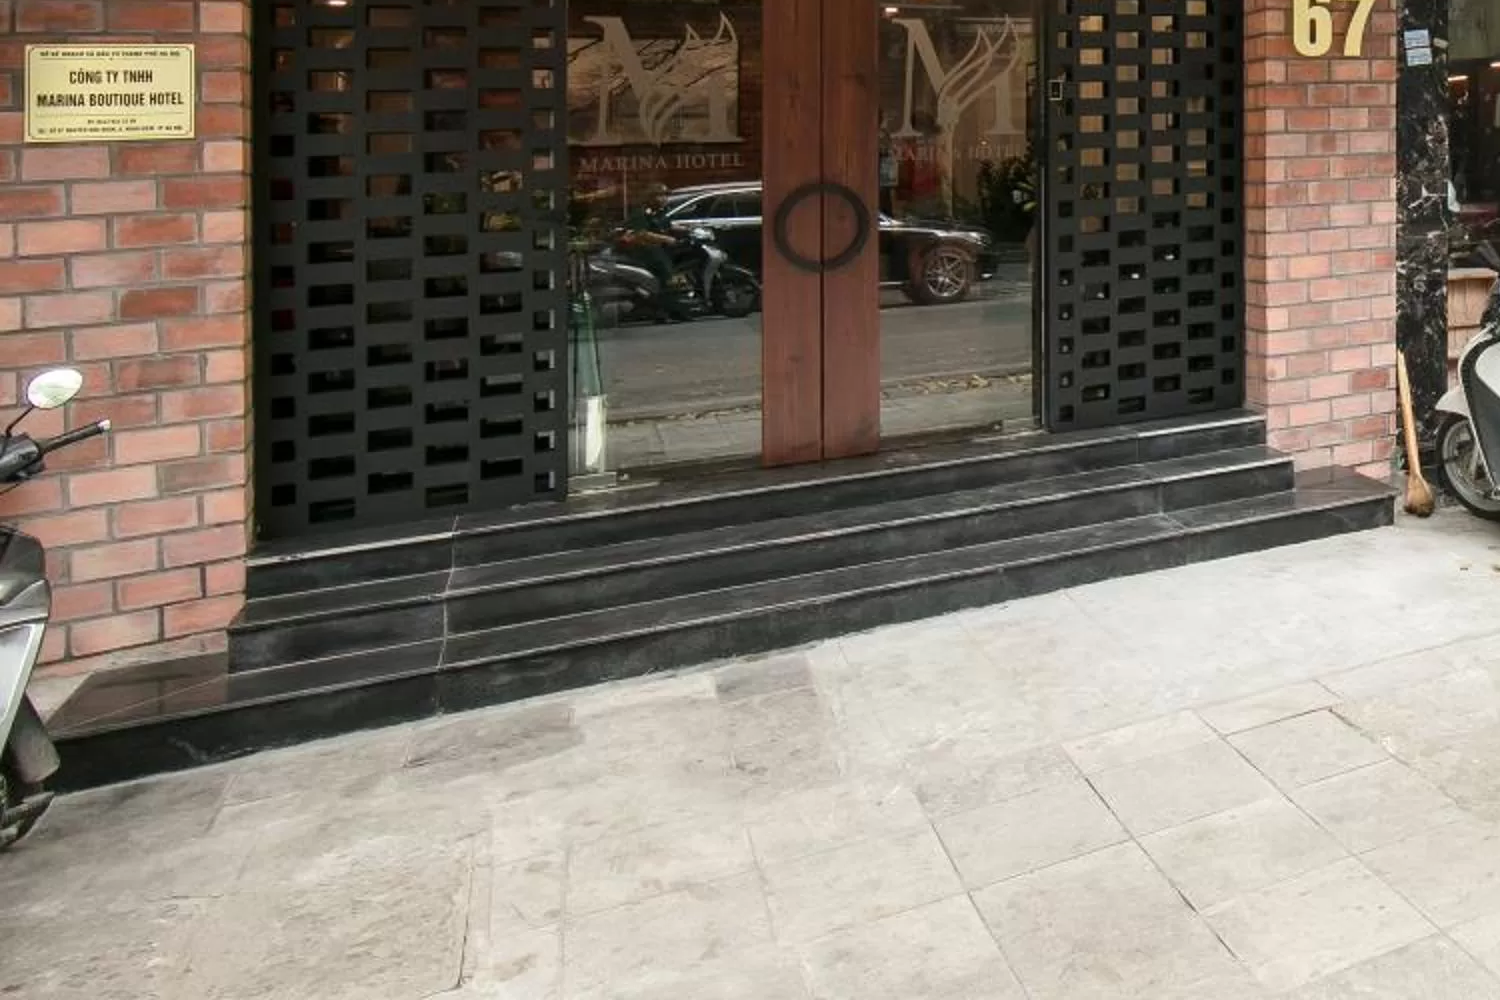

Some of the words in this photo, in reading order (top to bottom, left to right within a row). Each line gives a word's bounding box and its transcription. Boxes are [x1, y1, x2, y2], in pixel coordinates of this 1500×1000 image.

[69, 68, 102, 84] CÔNG
[106, 70, 118, 84] TY
[123, 69, 153, 84] TNHH
[36, 93, 85, 108] MARINA
[89, 92, 145, 107] BOUTIQUE
[149, 91, 184, 105] HOTEL
[676, 152, 744, 170] HOTEL
